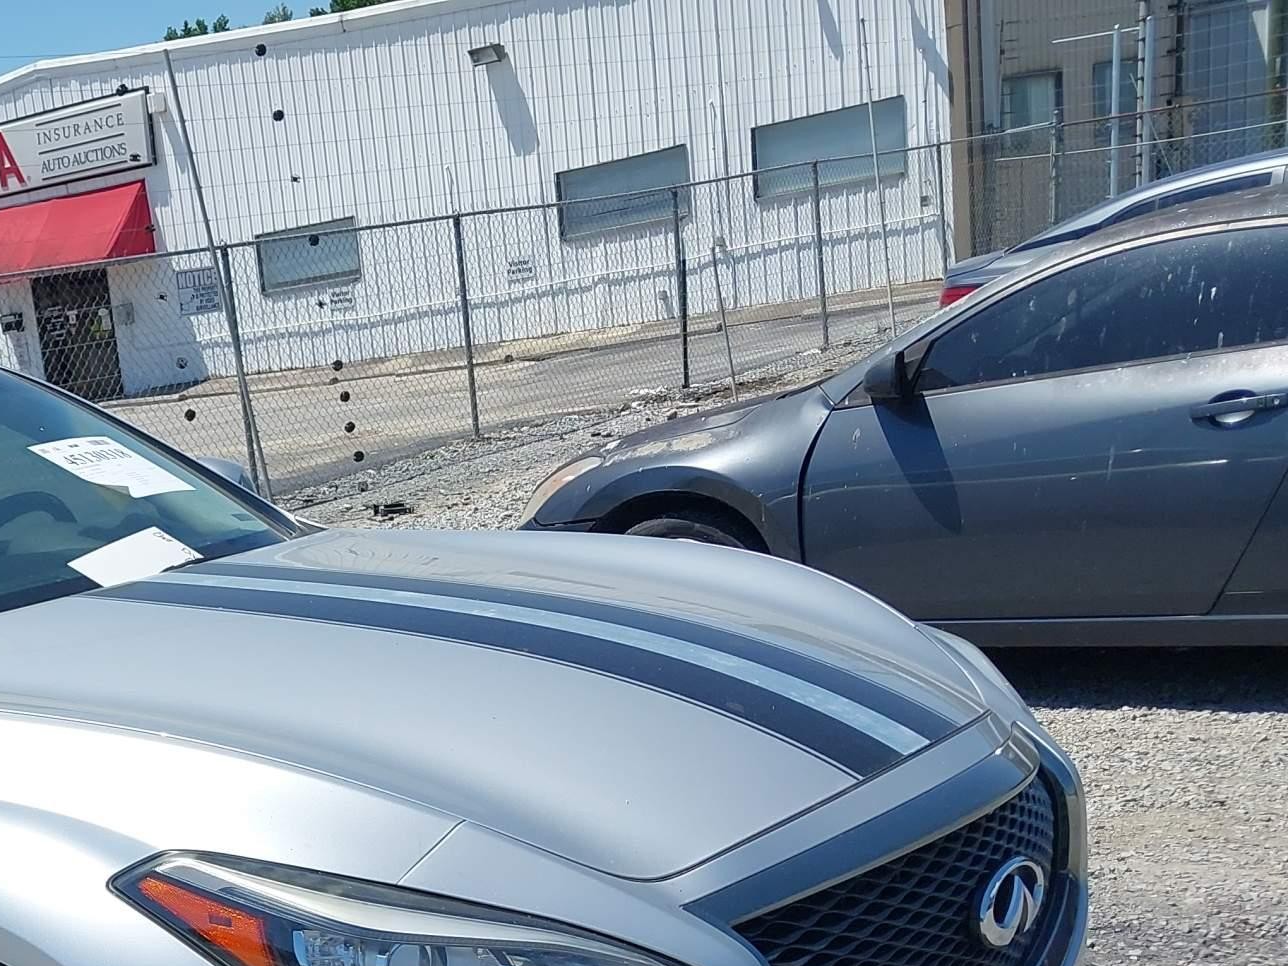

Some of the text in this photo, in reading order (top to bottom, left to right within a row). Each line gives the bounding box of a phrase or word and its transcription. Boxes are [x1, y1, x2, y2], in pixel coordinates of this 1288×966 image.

[37, 113, 125, 145] INSURANCE
[41, 142, 127, 174] AUTO AUCTIONS
[507, 266, 533, 276] Parking
[508, 259, 530, 268] Visitor
[177, 269, 218, 289] NOTICE
